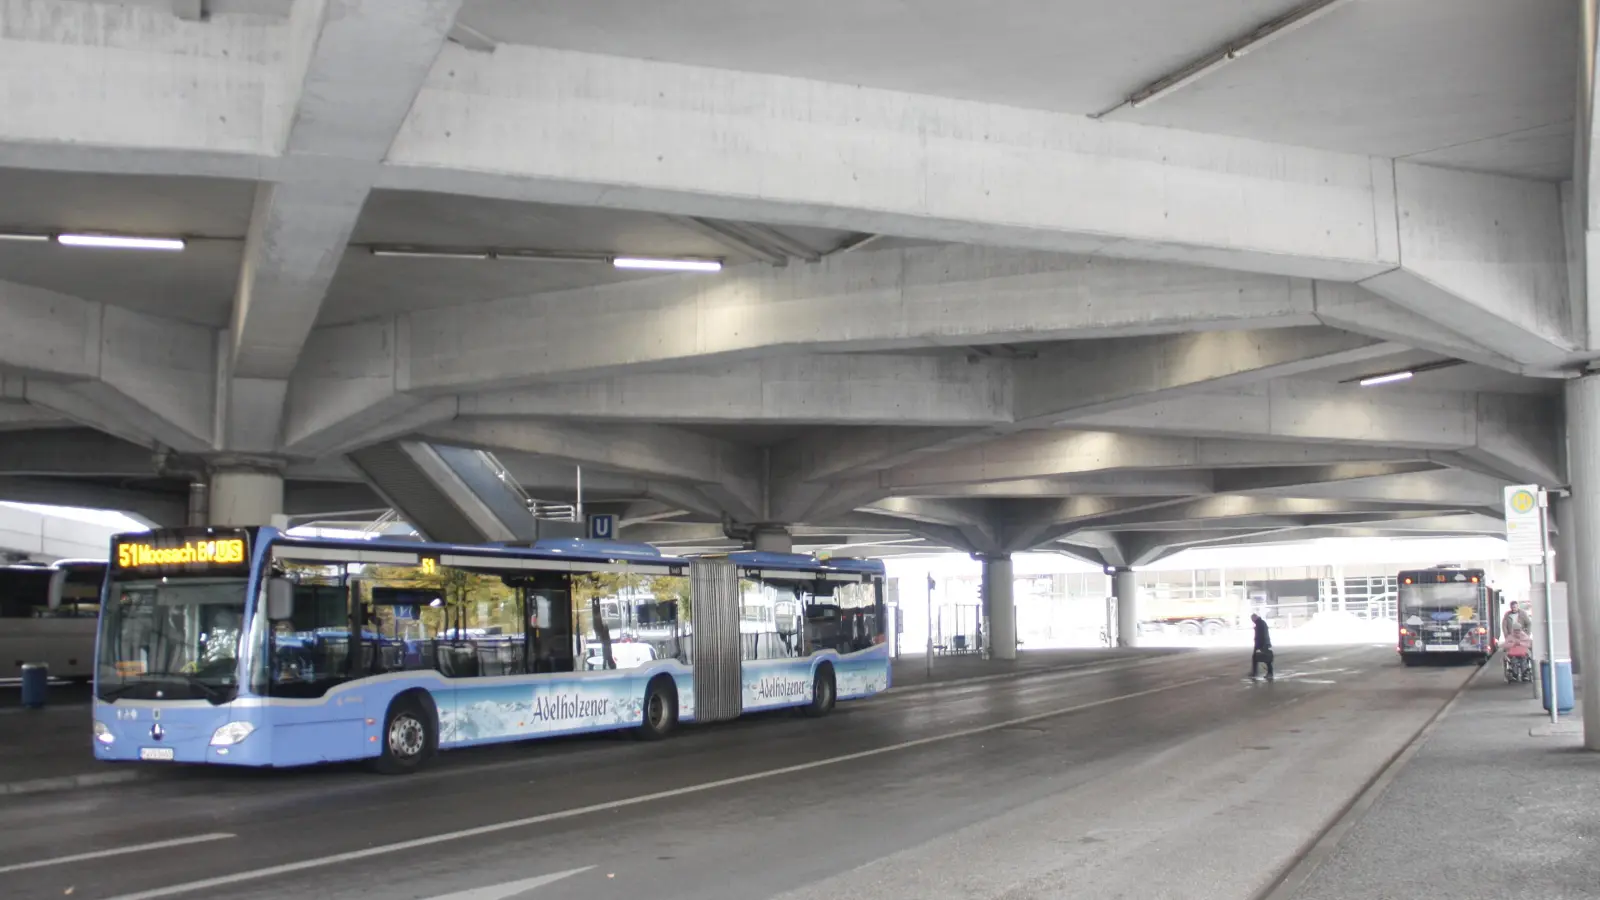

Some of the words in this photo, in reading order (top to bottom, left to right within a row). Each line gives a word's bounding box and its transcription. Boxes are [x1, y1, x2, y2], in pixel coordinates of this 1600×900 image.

[596, 518, 608, 536] U
[119, 543, 138, 567] 51
[138, 542, 197, 564] Moosach
[422, 558, 435, 574] 51
[757, 676, 805, 700] Adelholzener
[530, 691, 609, 724] Adelholzener
